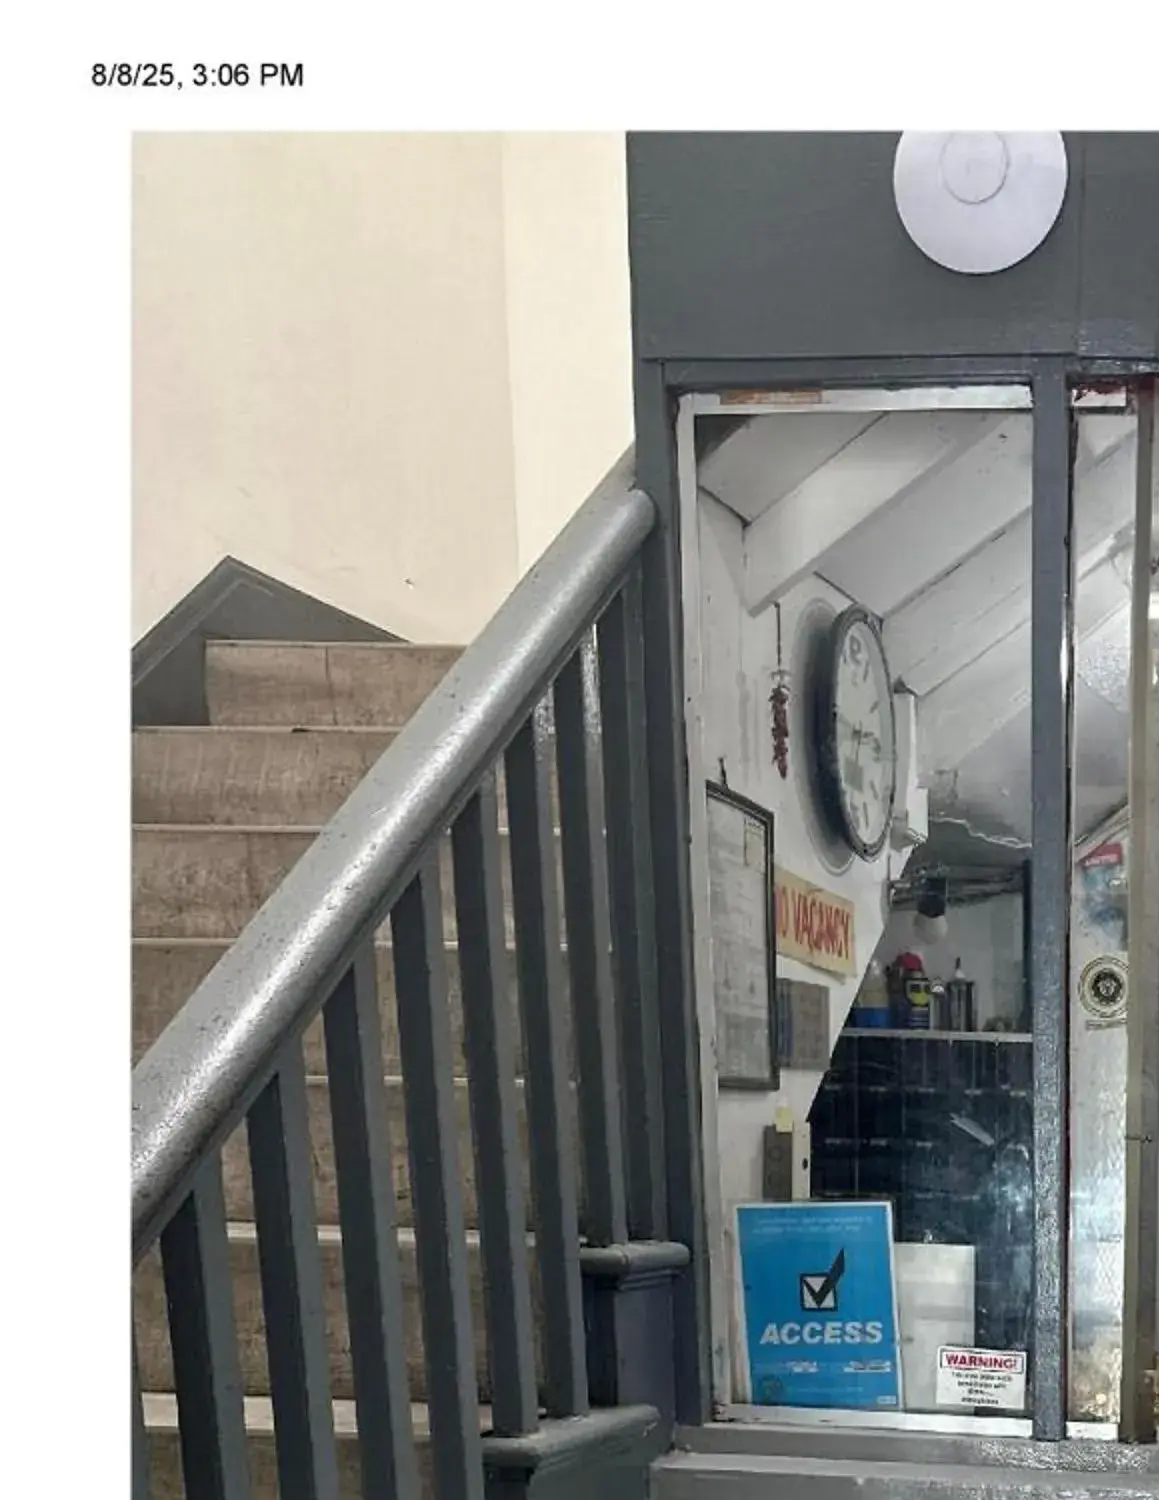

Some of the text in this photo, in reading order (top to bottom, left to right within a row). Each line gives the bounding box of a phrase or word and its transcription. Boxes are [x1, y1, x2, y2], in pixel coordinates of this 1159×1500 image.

[794, 890, 849, 960] VACANCY
[759, 1321, 883, 1345] ACCESS
[945, 1353, 1017, 1370] WARNING!
